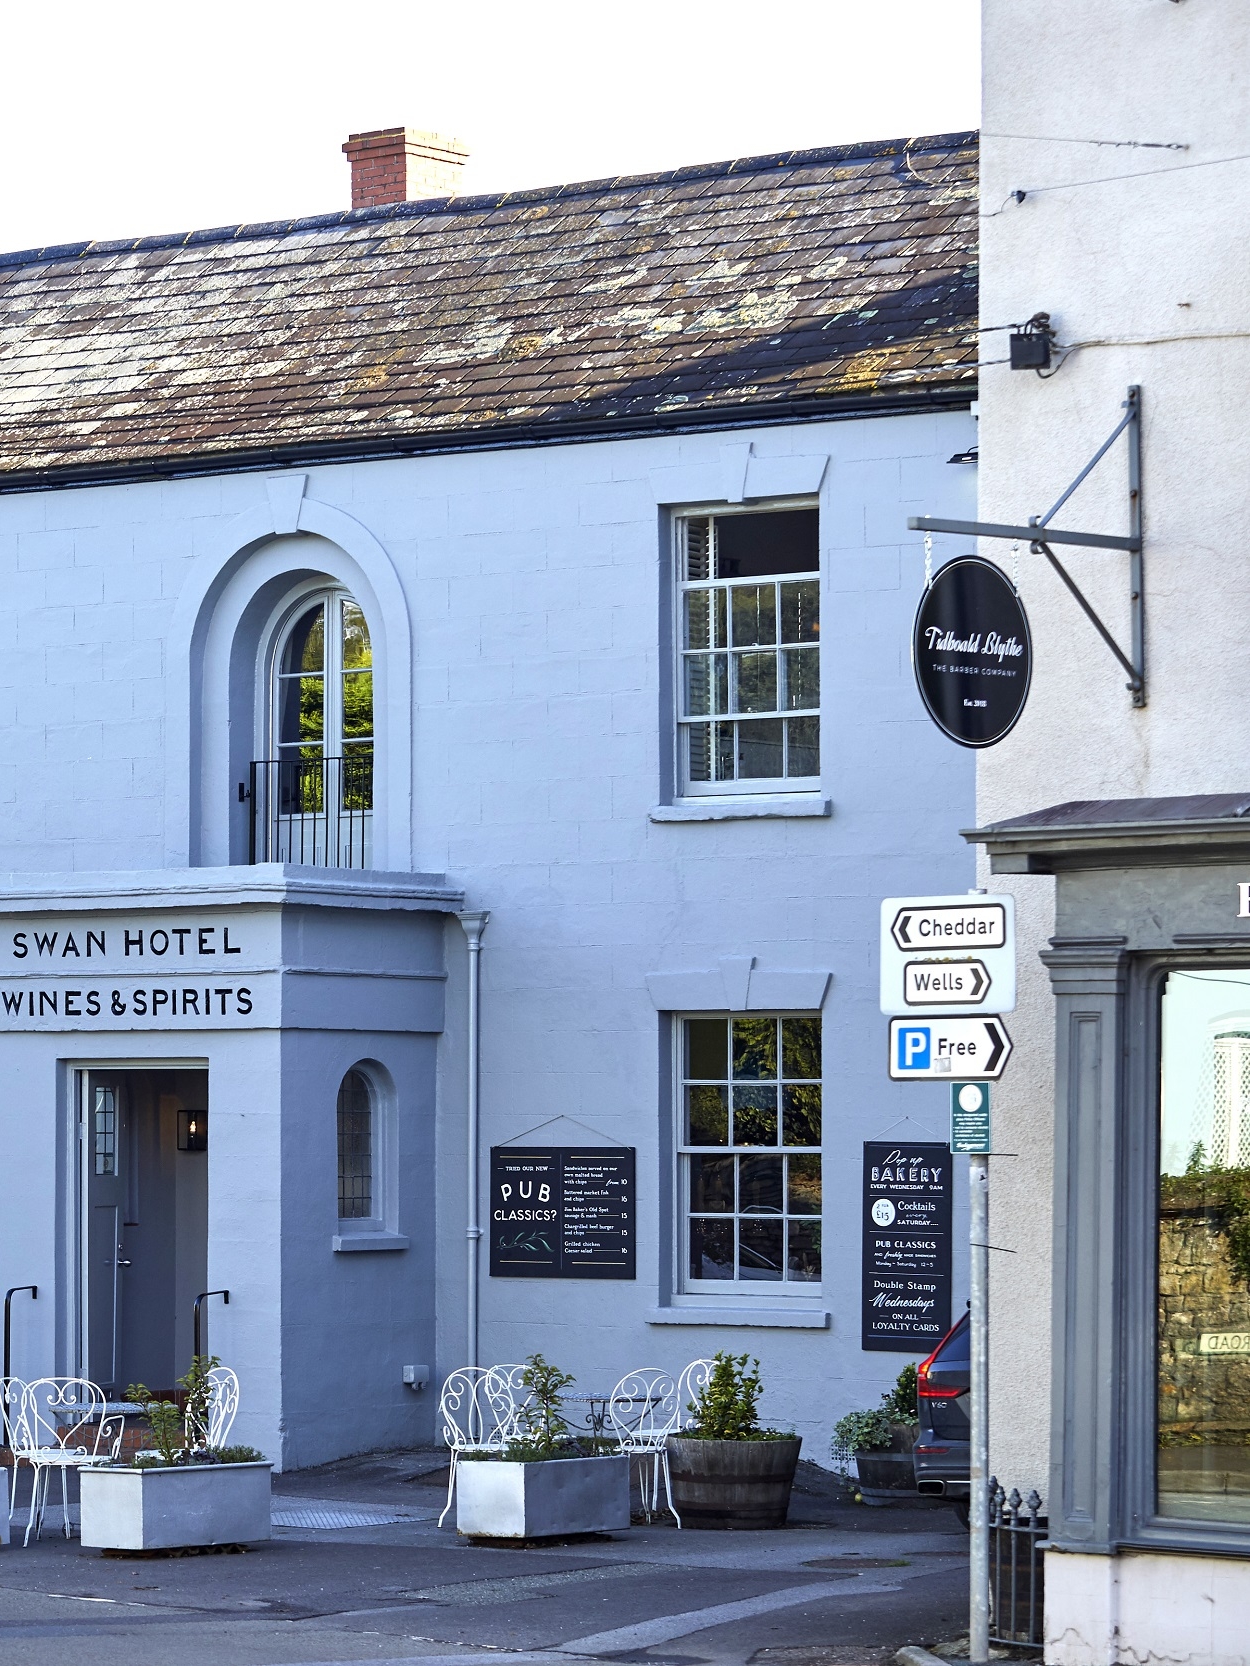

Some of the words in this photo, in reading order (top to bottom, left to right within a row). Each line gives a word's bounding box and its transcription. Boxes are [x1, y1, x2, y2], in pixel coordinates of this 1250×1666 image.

[981, 632, 1023, 662] Blythe
[933, 664, 947, 672] THE
[950, 665, 979, 674] BARBER
[981, 668, 1016, 677] COMPANY
[919, 917, 995, 937] Cheddar
[13, 931, 106, 958] SWAN
[124, 927, 241, 956] HOTEL
[914, 973, 963, 991] Wells
[2, 990, 101, 1016] WINES
[111, 990, 127, 1016] &
[133, 987, 253, 1016] SPIRITS
[905, 1032, 927, 1066] P
[937, 1038, 976, 1055] Free
[882, 1150, 907, 1166] Pop
[910, 1156, 924, 1166] up
[871, 1166, 942, 1182] BAKERY
[501, 1181, 550, 1202] PUB
[898, 1201, 936, 1211] Cocktails
[494, 1210, 557, 1221] CLASSICS?
[877, 1210, 889, 1220] £15
[894, 1241, 936, 1249] CLASSICS
[884, 1251, 903, 1260] freshly
[874, 1280, 904, 1289] Double
[908, 1281, 936, 1292] Stamp
[869, 1292, 934, 1313] Wednesdays
[872, 1322, 910, 1330] LOYALTY
